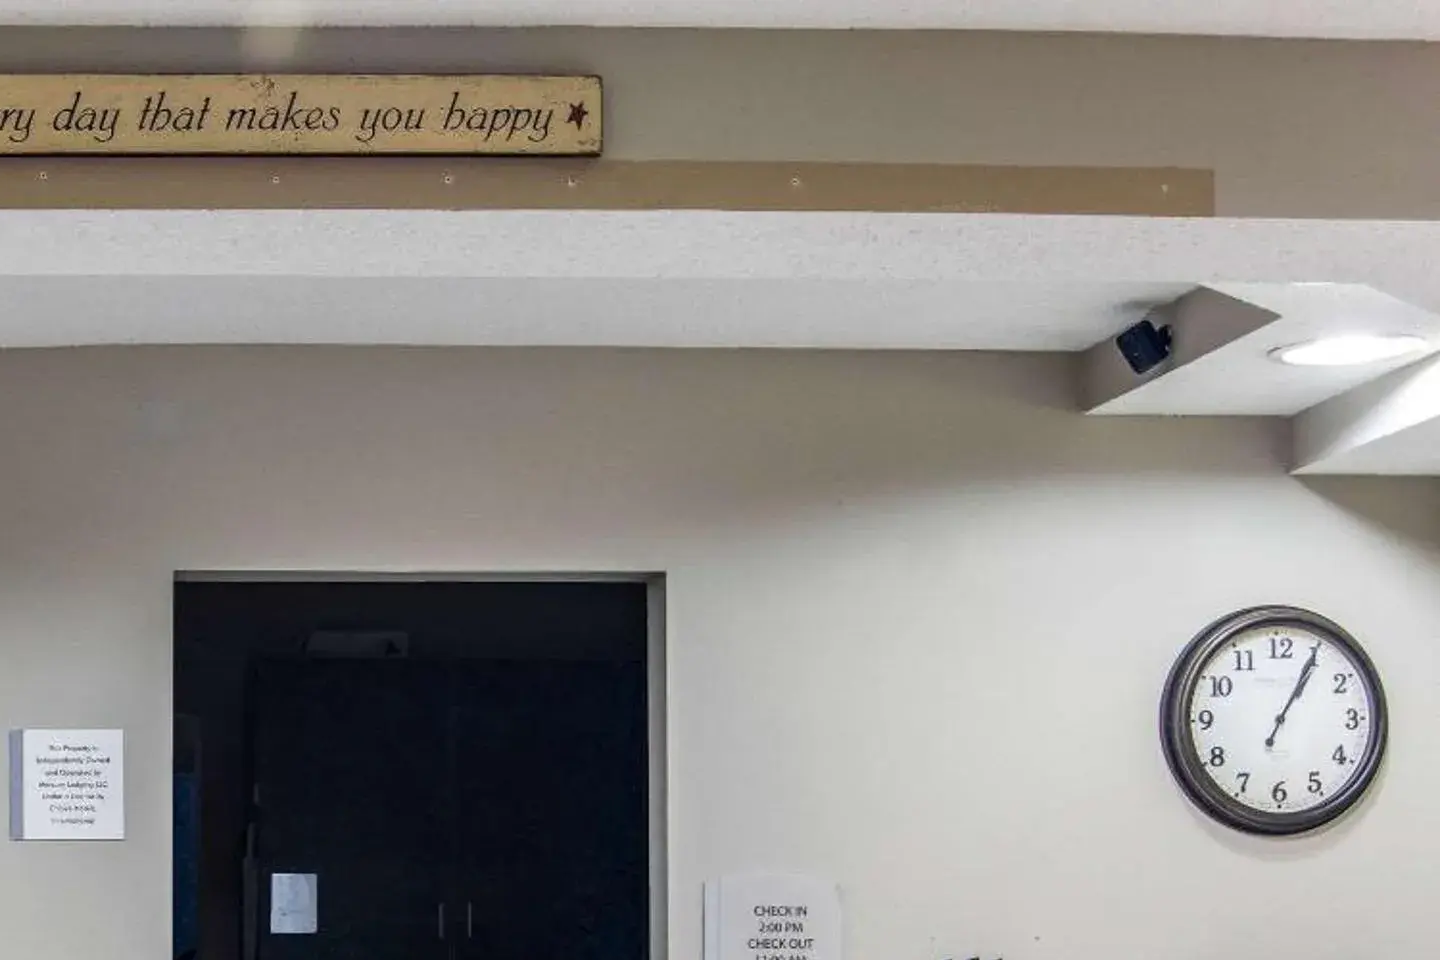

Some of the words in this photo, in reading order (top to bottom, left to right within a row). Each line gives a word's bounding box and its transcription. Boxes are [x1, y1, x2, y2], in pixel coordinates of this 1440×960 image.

[52, 91, 121, 142] day
[137, 91, 212, 132] that
[225, 92, 342, 132] makes
[355, 103, 426, 142] you
[442, 92, 554, 141] happy
[1268, 638, 1293, 659] 12
[1234, 650, 1255, 671] 11
[1210, 675, 1232, 697] 10
[1333, 673, 1347, 694] 2
[1198, 709, 1214, 730] 9
[1345, 708, 1359, 730] 3
[1210, 746, 1225, 767] 8
[1332, 744, 1347, 765] 4
[1236, 772, 1250, 793] 7
[1272, 781, 1287, 802] 6
[1307, 772, 1322, 793] 5
[753, 905, 792, 916] CHECK
[794, 905, 807, 916] IN
[785, 922, 803, 933] PM
[748, 938, 786, 949] CHECK
[789, 938, 814, 949] OUT
